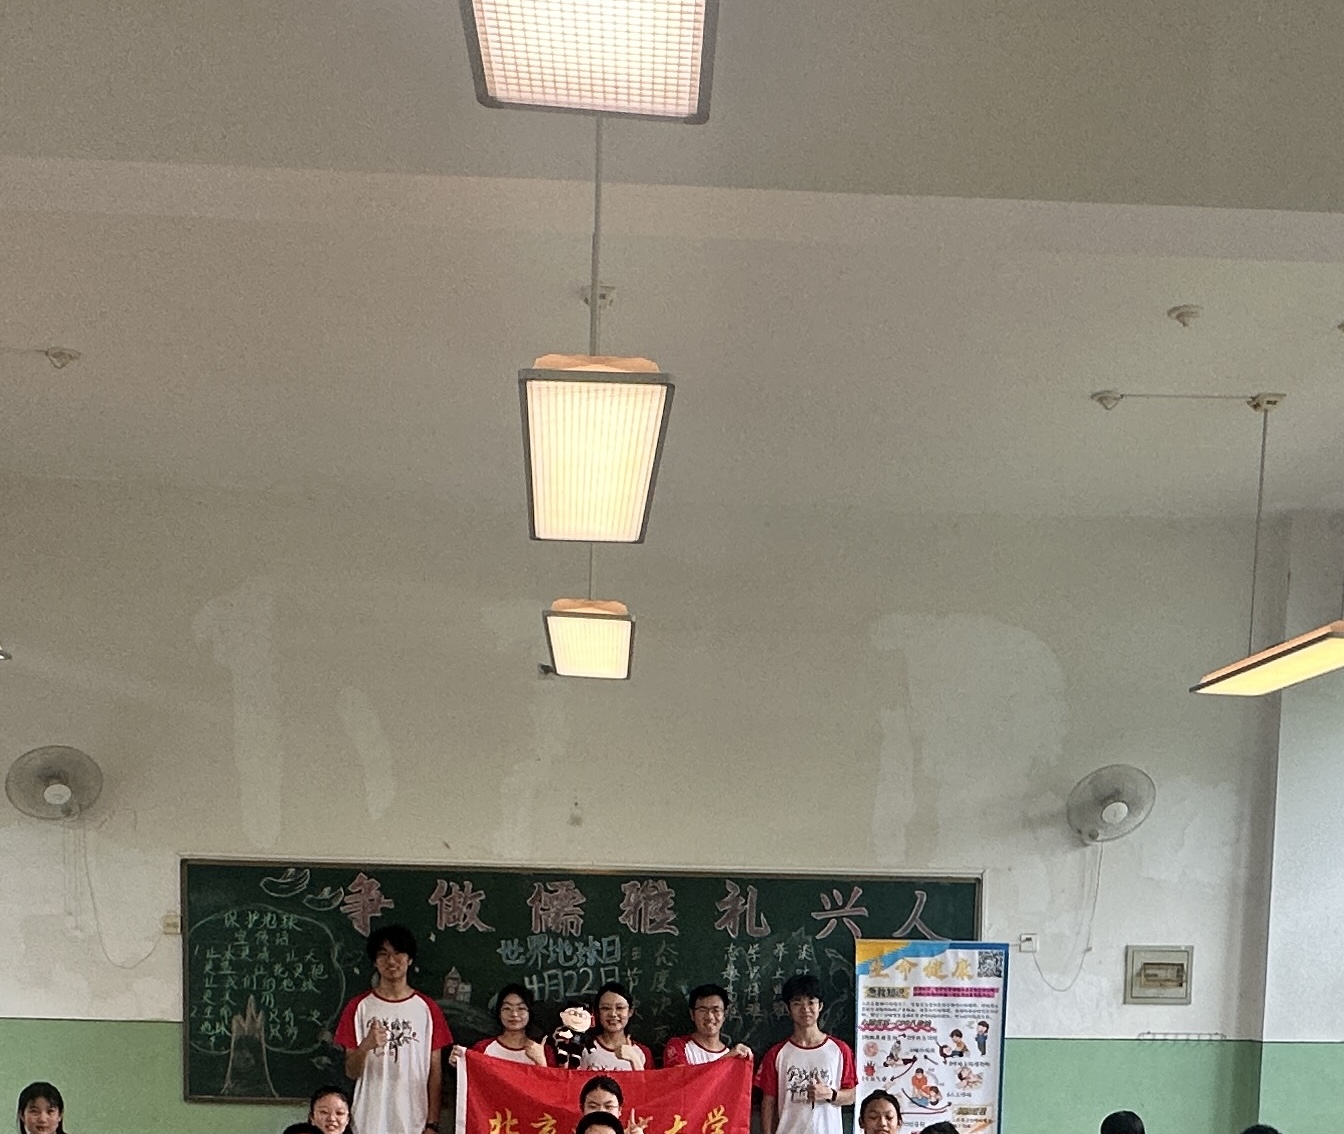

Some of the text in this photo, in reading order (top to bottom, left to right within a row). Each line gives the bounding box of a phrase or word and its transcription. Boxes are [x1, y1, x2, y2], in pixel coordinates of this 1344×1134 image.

[224, 911, 302, 931] 保护地球
[340, 872, 952, 941] 争做儒雅礼兴人
[497, 934, 621, 970] 世界地球日
[869, 956, 974, 981] 生命健康
[524, 966, 619, 1001] 4月22日
